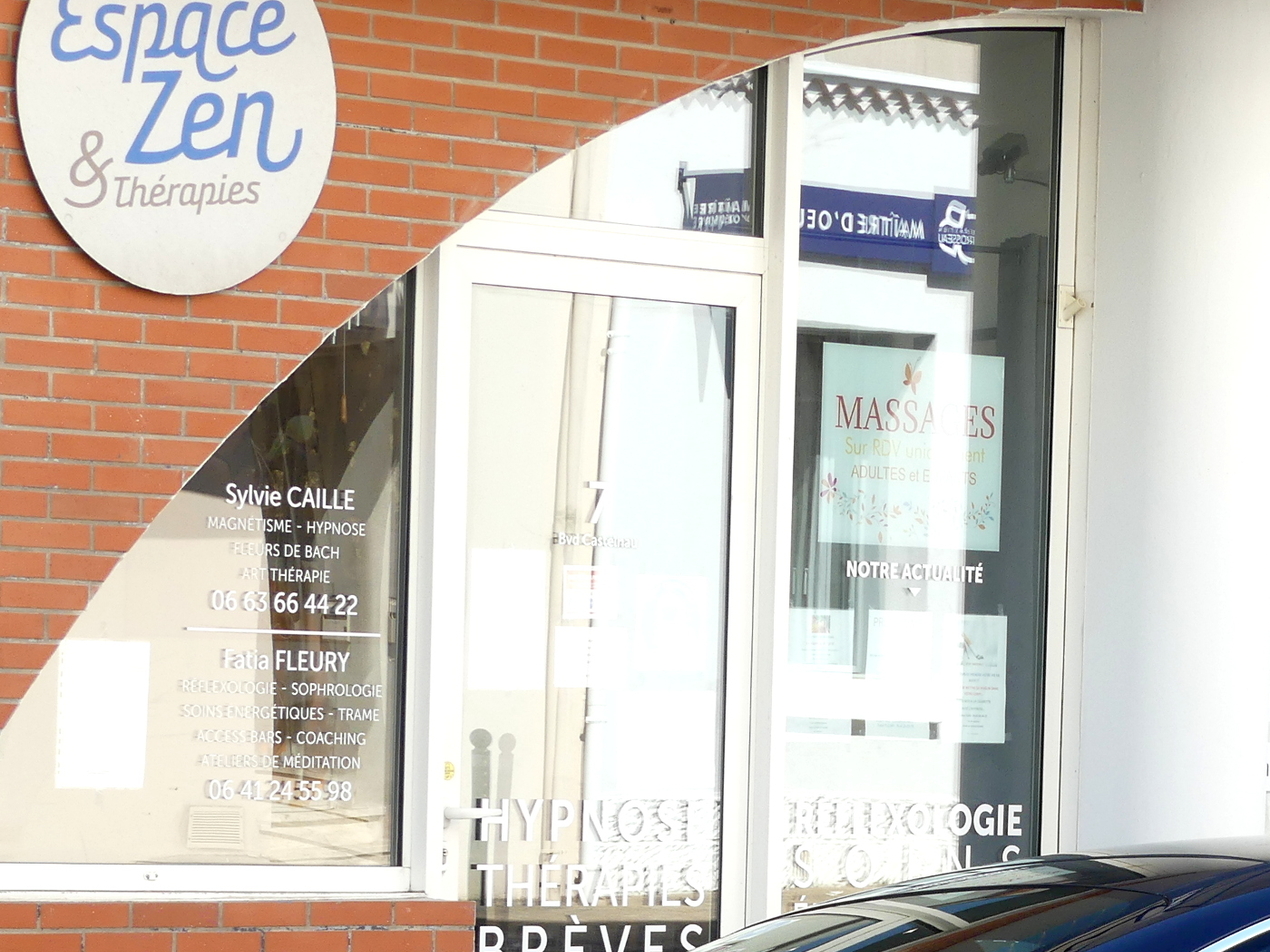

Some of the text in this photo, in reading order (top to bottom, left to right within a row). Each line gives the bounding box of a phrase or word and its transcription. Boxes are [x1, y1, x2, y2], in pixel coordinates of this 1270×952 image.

[51, 0, 297, 83] Espace
[125, 70, 304, 173] Zen
[64, 130, 261, 216] & Thérapies
[835, 395, 996, 440] MASSAGES
[845, 436, 868, 455] Sur
[872, 438, 901, 457] RDV
[851, 464, 906, 481] ADULTES
[909, 470, 920, 482] et
[226, 483, 356, 511] Sylvie CAILLE
[207, 516, 292, 533] MAGNÉTISME
[306, 521, 366, 537] HYPNOSE
[558, 532, 579, 546] Bvd
[234, 543, 340, 560] FLEURS DE BACH
[243, 566, 331, 584] ART THÉRAPIE
[846, 560, 984, 584] NOTRE ACTUALITÉ
[212, 589, 358, 616] 06 63 66 44 22
[224, 648, 350, 673] Fatia FLEURY
[182, 680, 277, 696] RÉFLEXOLOGIE
[291, 682, 383, 698] SOPHROLOGIE
[182, 704, 223, 718] SOINS
[338, 707, 380, 722] TRAME
[197, 730, 247, 744] ACCESS
[251, 731, 282, 745] BARS
[296, 731, 367, 746] COACHING
[201, 753, 361, 770] ATELIERS DE MÉDITATION
[208, 779, 352, 802] 06 41 24 55 98
[477, 853, 705, 908] THÉRAPIES
